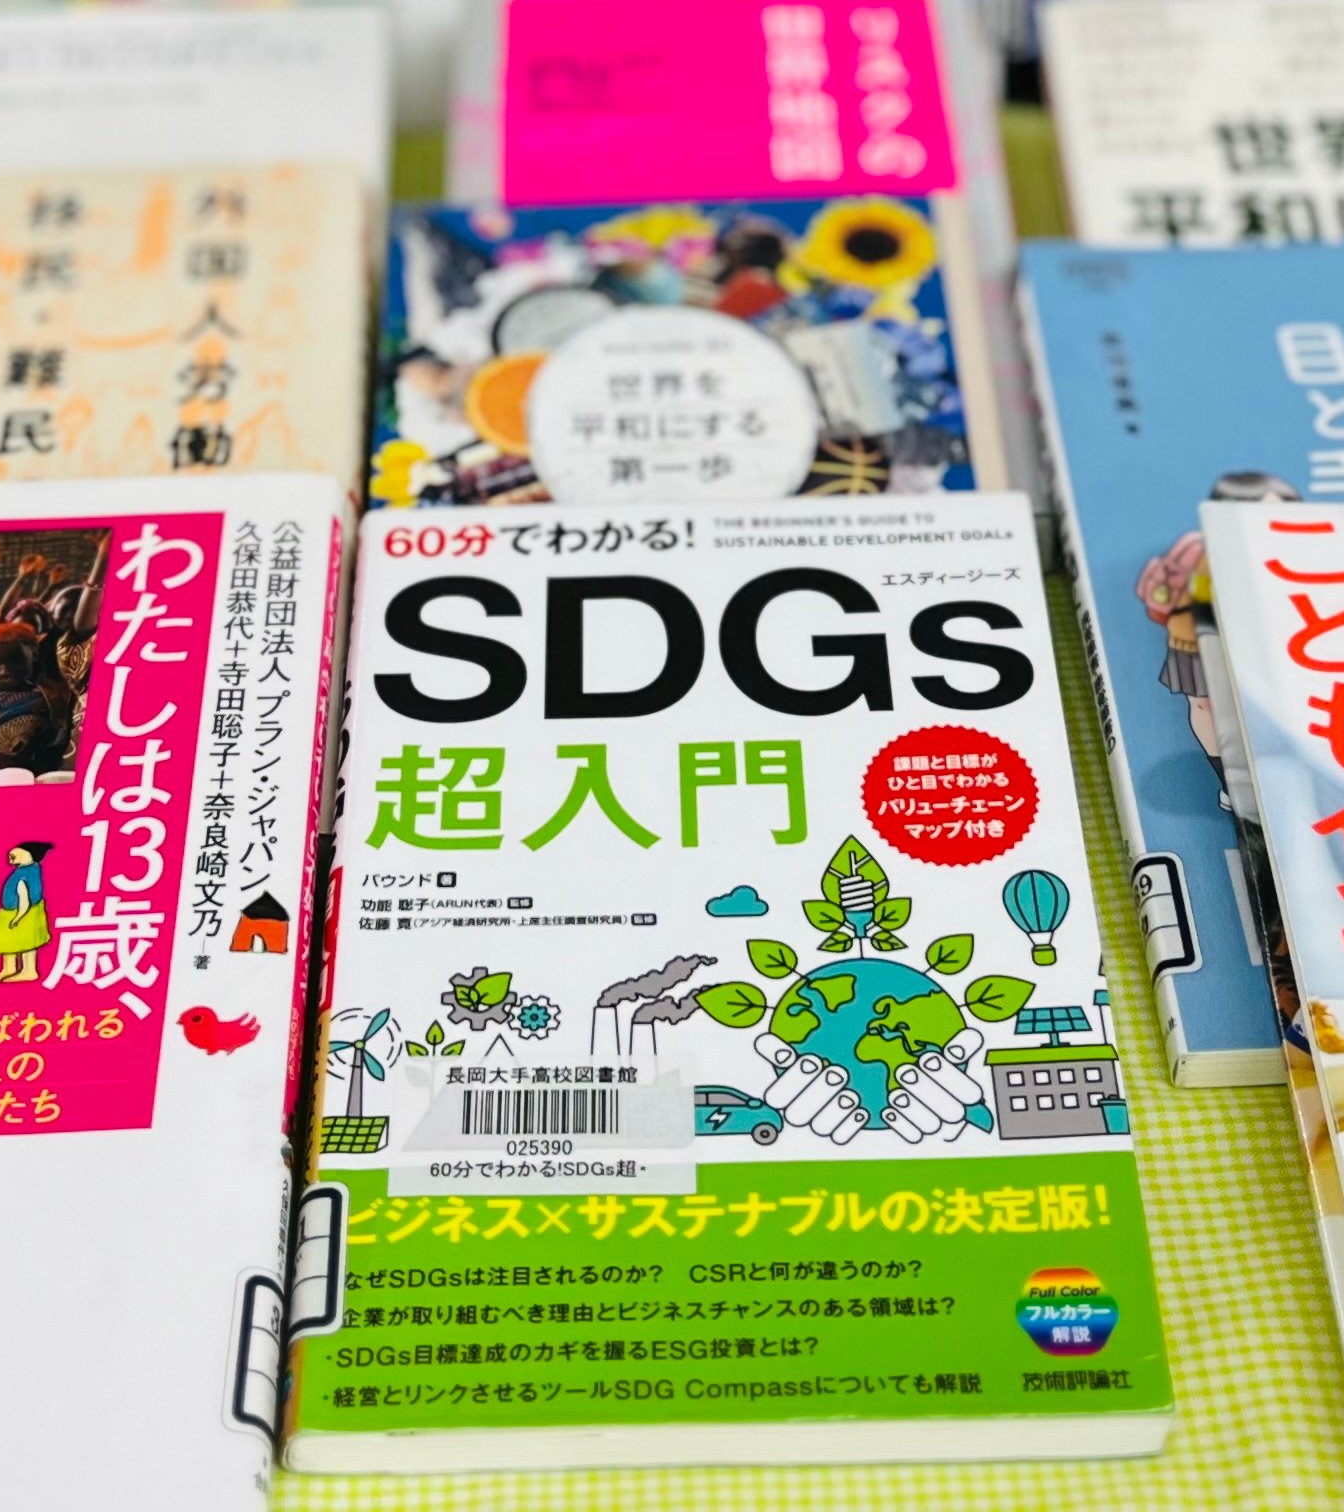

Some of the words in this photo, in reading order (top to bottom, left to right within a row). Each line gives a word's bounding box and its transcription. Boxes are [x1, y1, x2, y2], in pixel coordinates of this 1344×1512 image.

[168, 186, 252, 472] 外国人労働
[383, 520, 696, 560] 60分でわかる!
[713, 536, 830, 549] SUSTAINABLE
[833, 531, 957, 547] DEVELOPMENT
[880, 566, 1022, 587] エスディージーズ
[256, 519, 306, 684] 公益財団法人
[372, 566, 1036, 724] SDGs
[40, 522, 204, 1022] わたしは13歳、
[893, 753, 998, 772] 課題と目標が
[238, 690, 294, 894] プラン・ジャパン
[887, 772, 1010, 791] ひと目でわかる
[364, 739, 812, 852] 超入門
[877, 794, 1026, 816] バリューチェーン
[904, 819, 1006, 839] マップ付き
[361, 872, 432, 888] バウンド
[445, 1066, 639, 1085] 長岡大手高校図書館
[505, 1140, 574, 1156] 025390
[688, 1260, 924, 1284] CSRと何が違うのか?
[342, 1295, 956, 1329] 企業が取り組むべき理由とビジネスチャンスのある領域は?
[1025, 1304, 1112, 1321] フルカラー
[1051, 1325, 1092, 1344] 解説
[684, 1373, 983, 1402] Compassについても解説
[1022, 1369, 1134, 1392] 技術評論社
